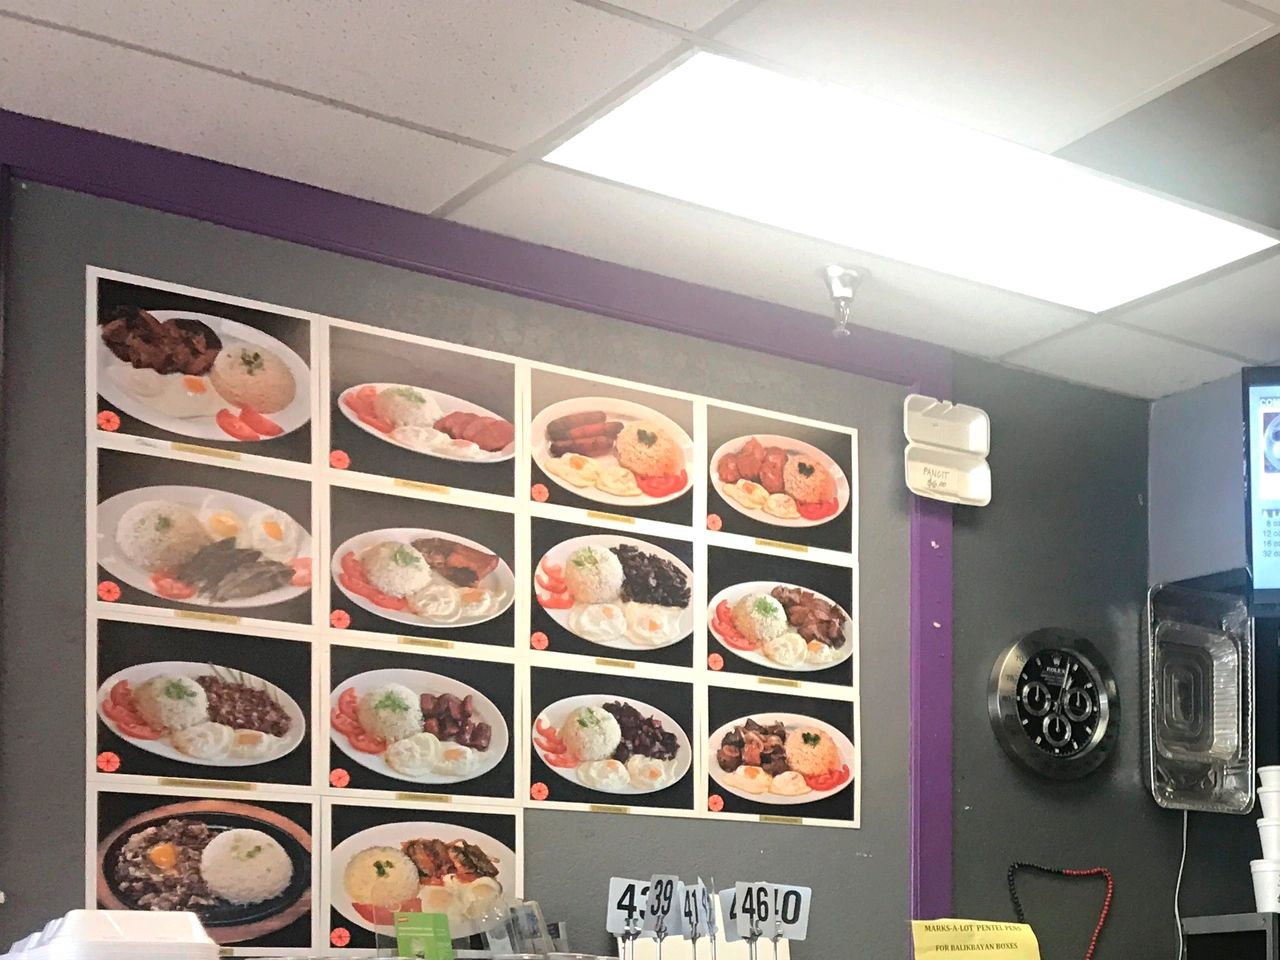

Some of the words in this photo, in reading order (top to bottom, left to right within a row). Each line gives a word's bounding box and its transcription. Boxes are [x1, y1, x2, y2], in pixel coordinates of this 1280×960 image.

[651, 879, 673, 916] 39
[684, 889, 699, 919] 41
[742, 887, 768, 922] 46
